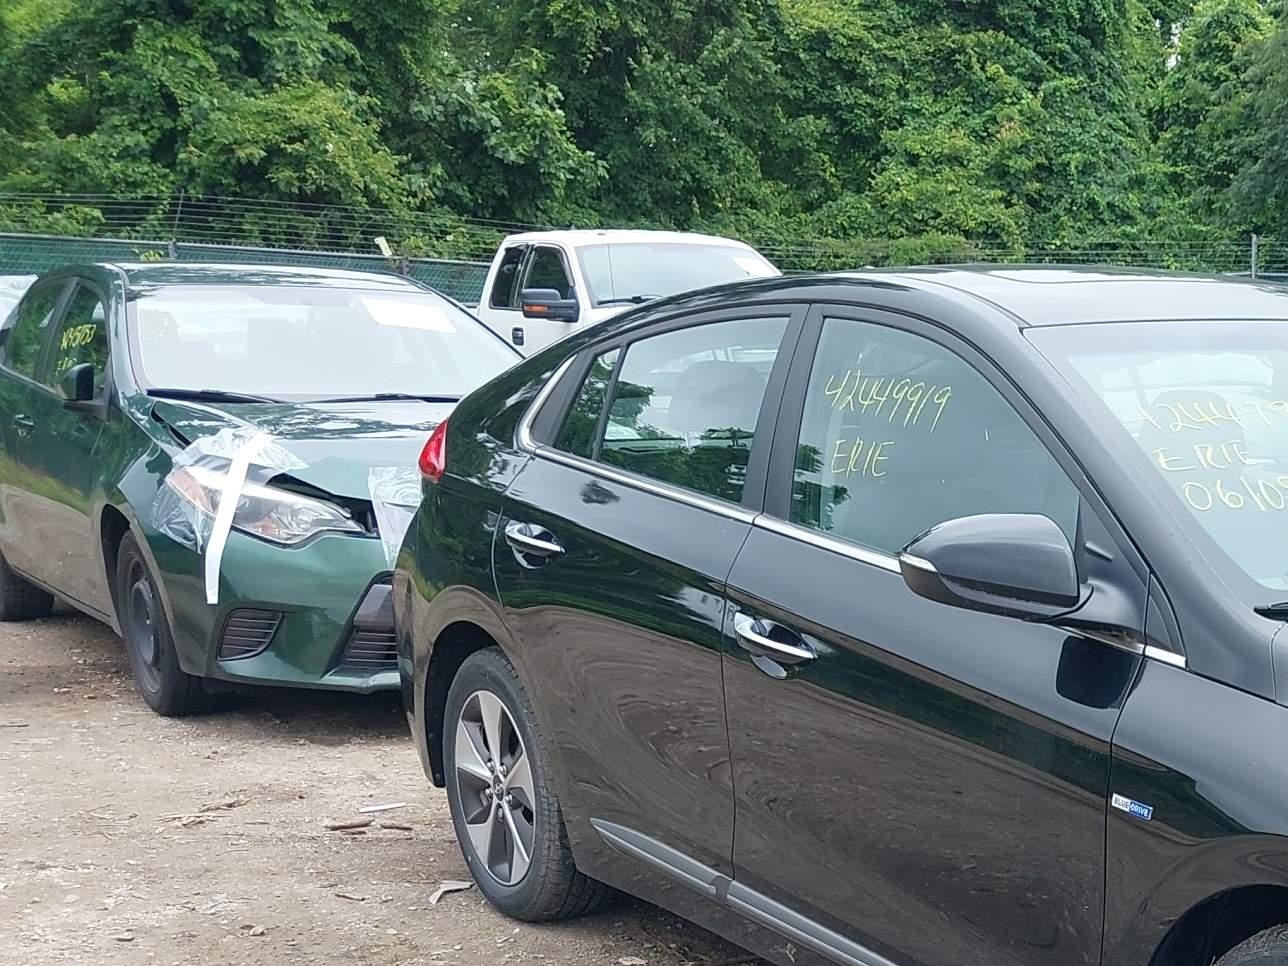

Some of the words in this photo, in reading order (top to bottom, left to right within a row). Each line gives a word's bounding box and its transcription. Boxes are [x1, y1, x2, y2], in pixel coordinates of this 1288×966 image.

[824, 369, 953, 433] 42449919
[831, 436, 896, 478] ERIE
[1152, 439, 1276, 471] ERIE
